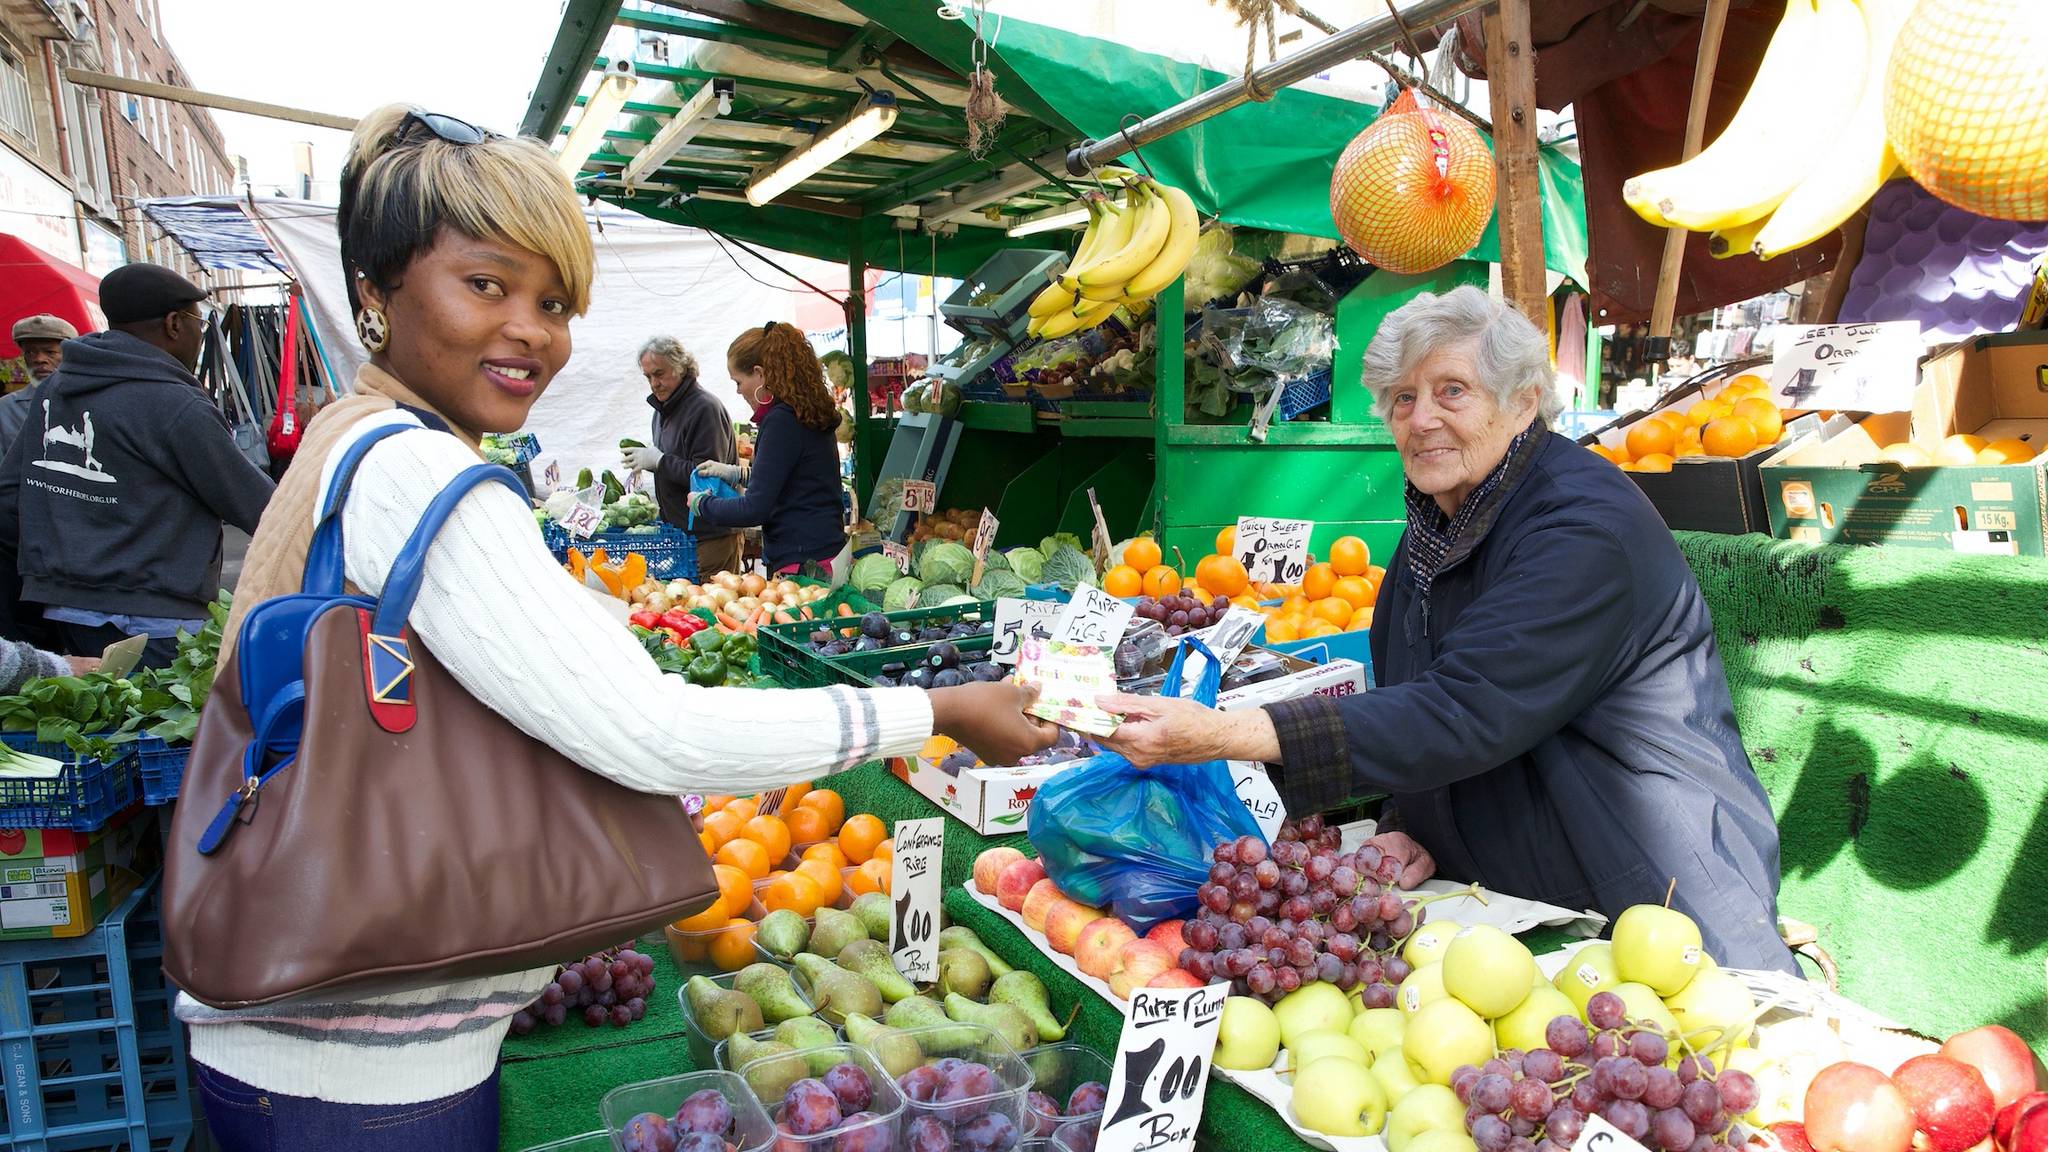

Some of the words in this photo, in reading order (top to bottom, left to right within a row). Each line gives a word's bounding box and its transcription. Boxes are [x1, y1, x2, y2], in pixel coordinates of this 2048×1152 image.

[1781, 368, 1823, 408] 4
[1240, 517, 1266, 537] JUICY
[1271, 520, 1308, 533] SWEET
[1982, 512, 1993, 525] 15
[1994, 514, 2009, 529] Kg.
[1254, 538, 1302, 553] ORANGE
[1240, 552, 1256, 579] 4
[1087, 589, 1120, 613] RIPE
[993, 619, 1023, 655] 5
[1074, 674, 1100, 687] veg
[1132, 993, 1179, 1021] RIPE
[15, 1063, 27, 1088] BEAN
[18, 1089, 28, 1097] &
[20, 1098, 32, 1124] SONS
